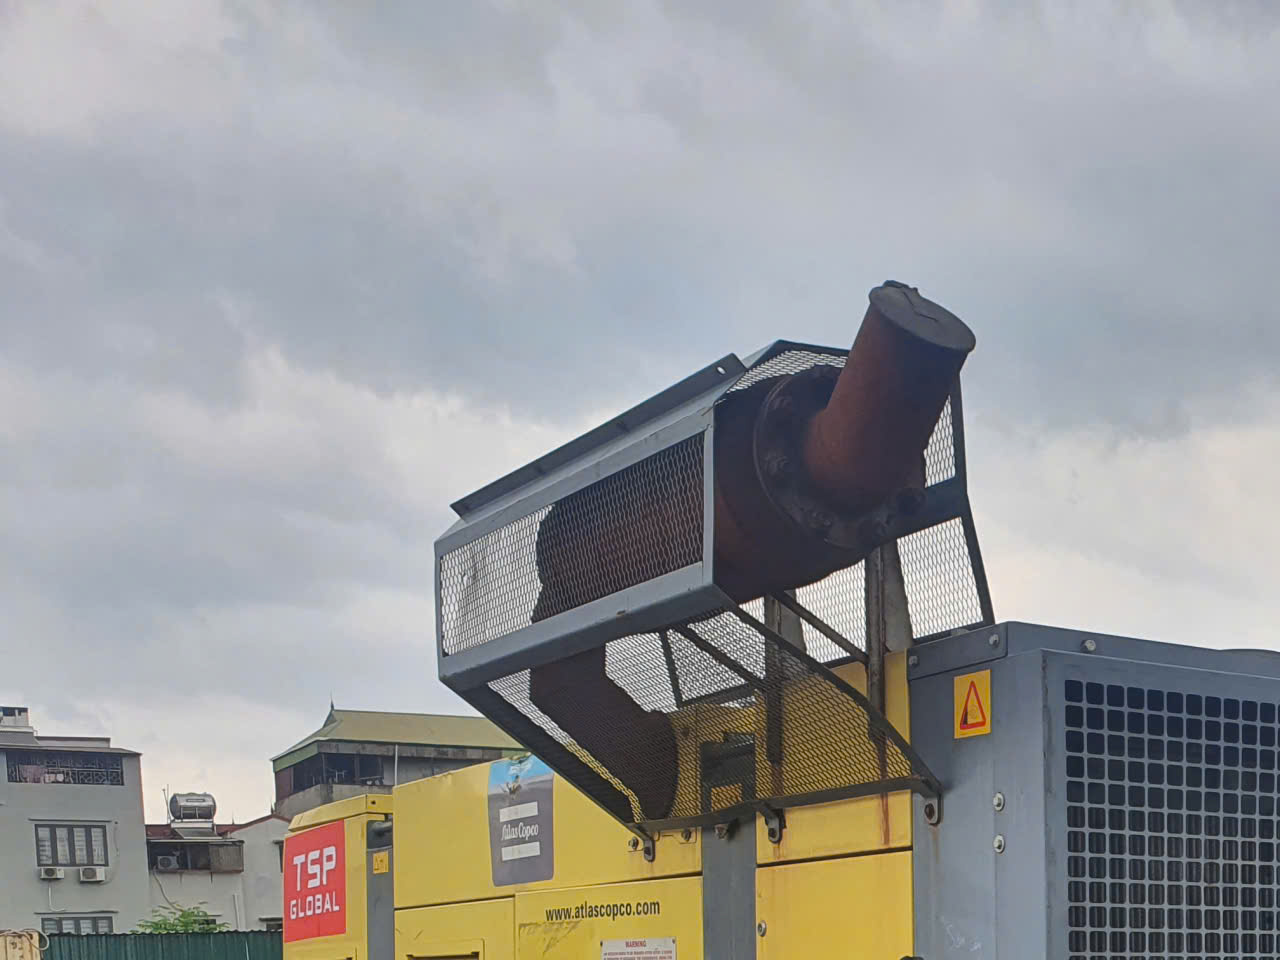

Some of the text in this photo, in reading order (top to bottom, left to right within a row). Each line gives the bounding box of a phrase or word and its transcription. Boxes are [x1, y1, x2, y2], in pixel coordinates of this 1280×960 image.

[501, 822, 539, 840] Atlas Copco
[293, 845, 336, 891] TSP
[290, 891, 340, 920] GLOBAL
[545, 900, 661, 921] www.atlascopco.com
